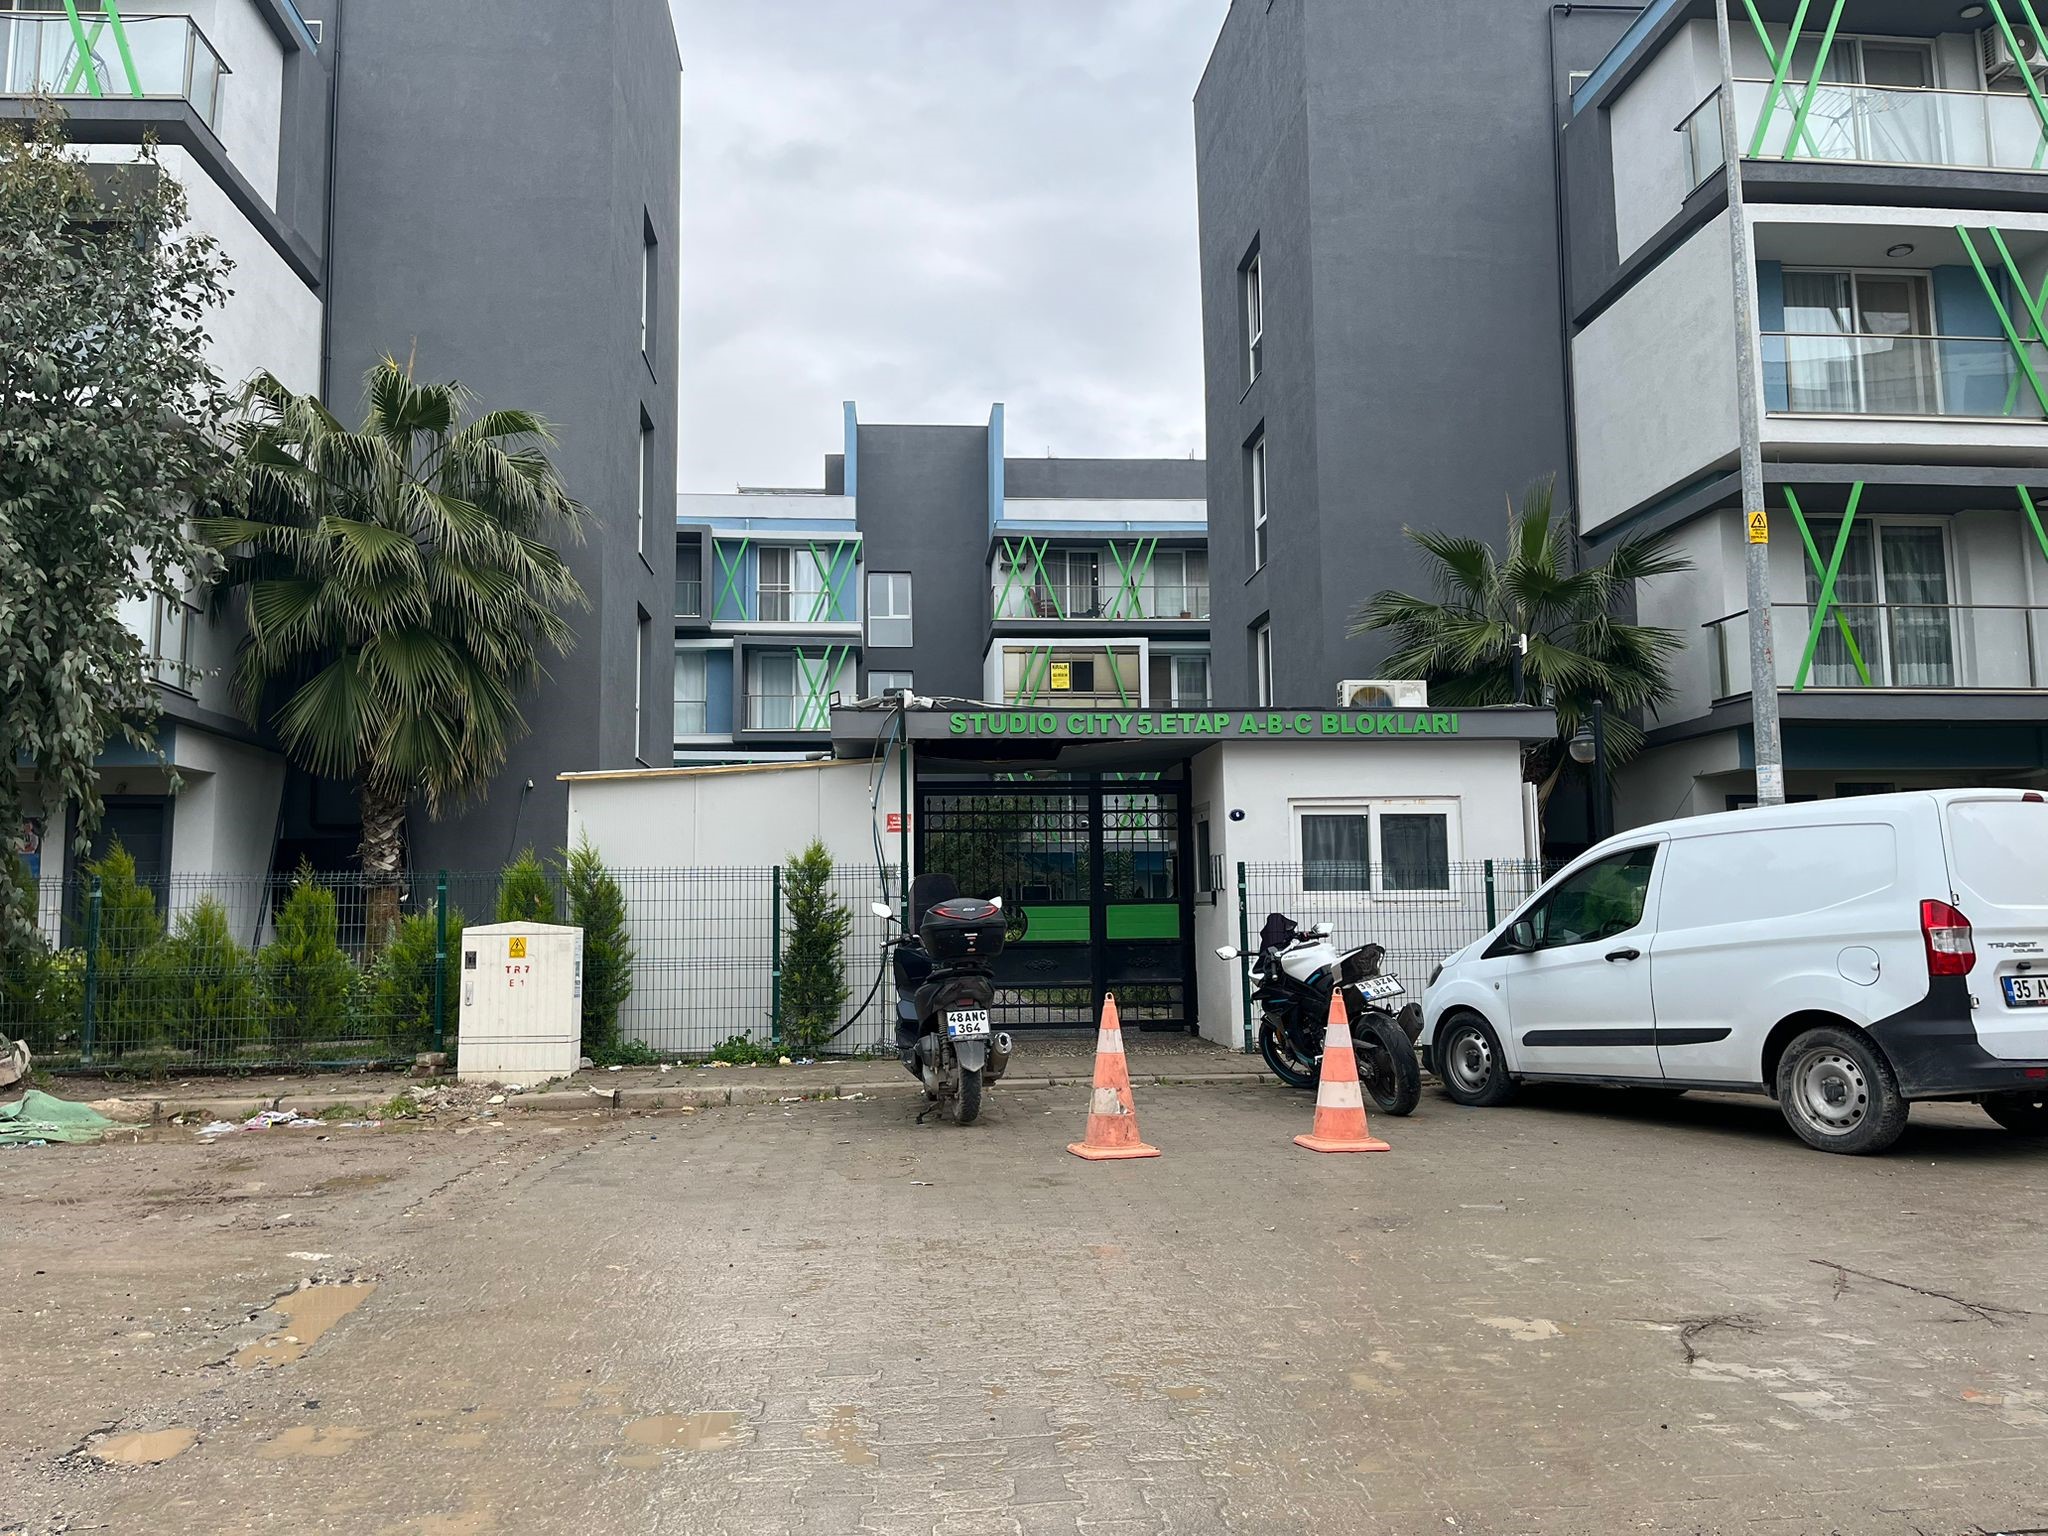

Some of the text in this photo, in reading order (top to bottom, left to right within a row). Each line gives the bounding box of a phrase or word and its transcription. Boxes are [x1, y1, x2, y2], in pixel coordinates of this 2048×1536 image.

[950, 713, 1057, 734] STUDIO
[1239, 713, 1312, 734] A-B-C
[1321, 713, 1459, 734] BLOKLARI
[1373, 985, 1392, 995] 941
[2013, 980, 2031, 999] 35
[958, 1022, 981, 1034] 364
